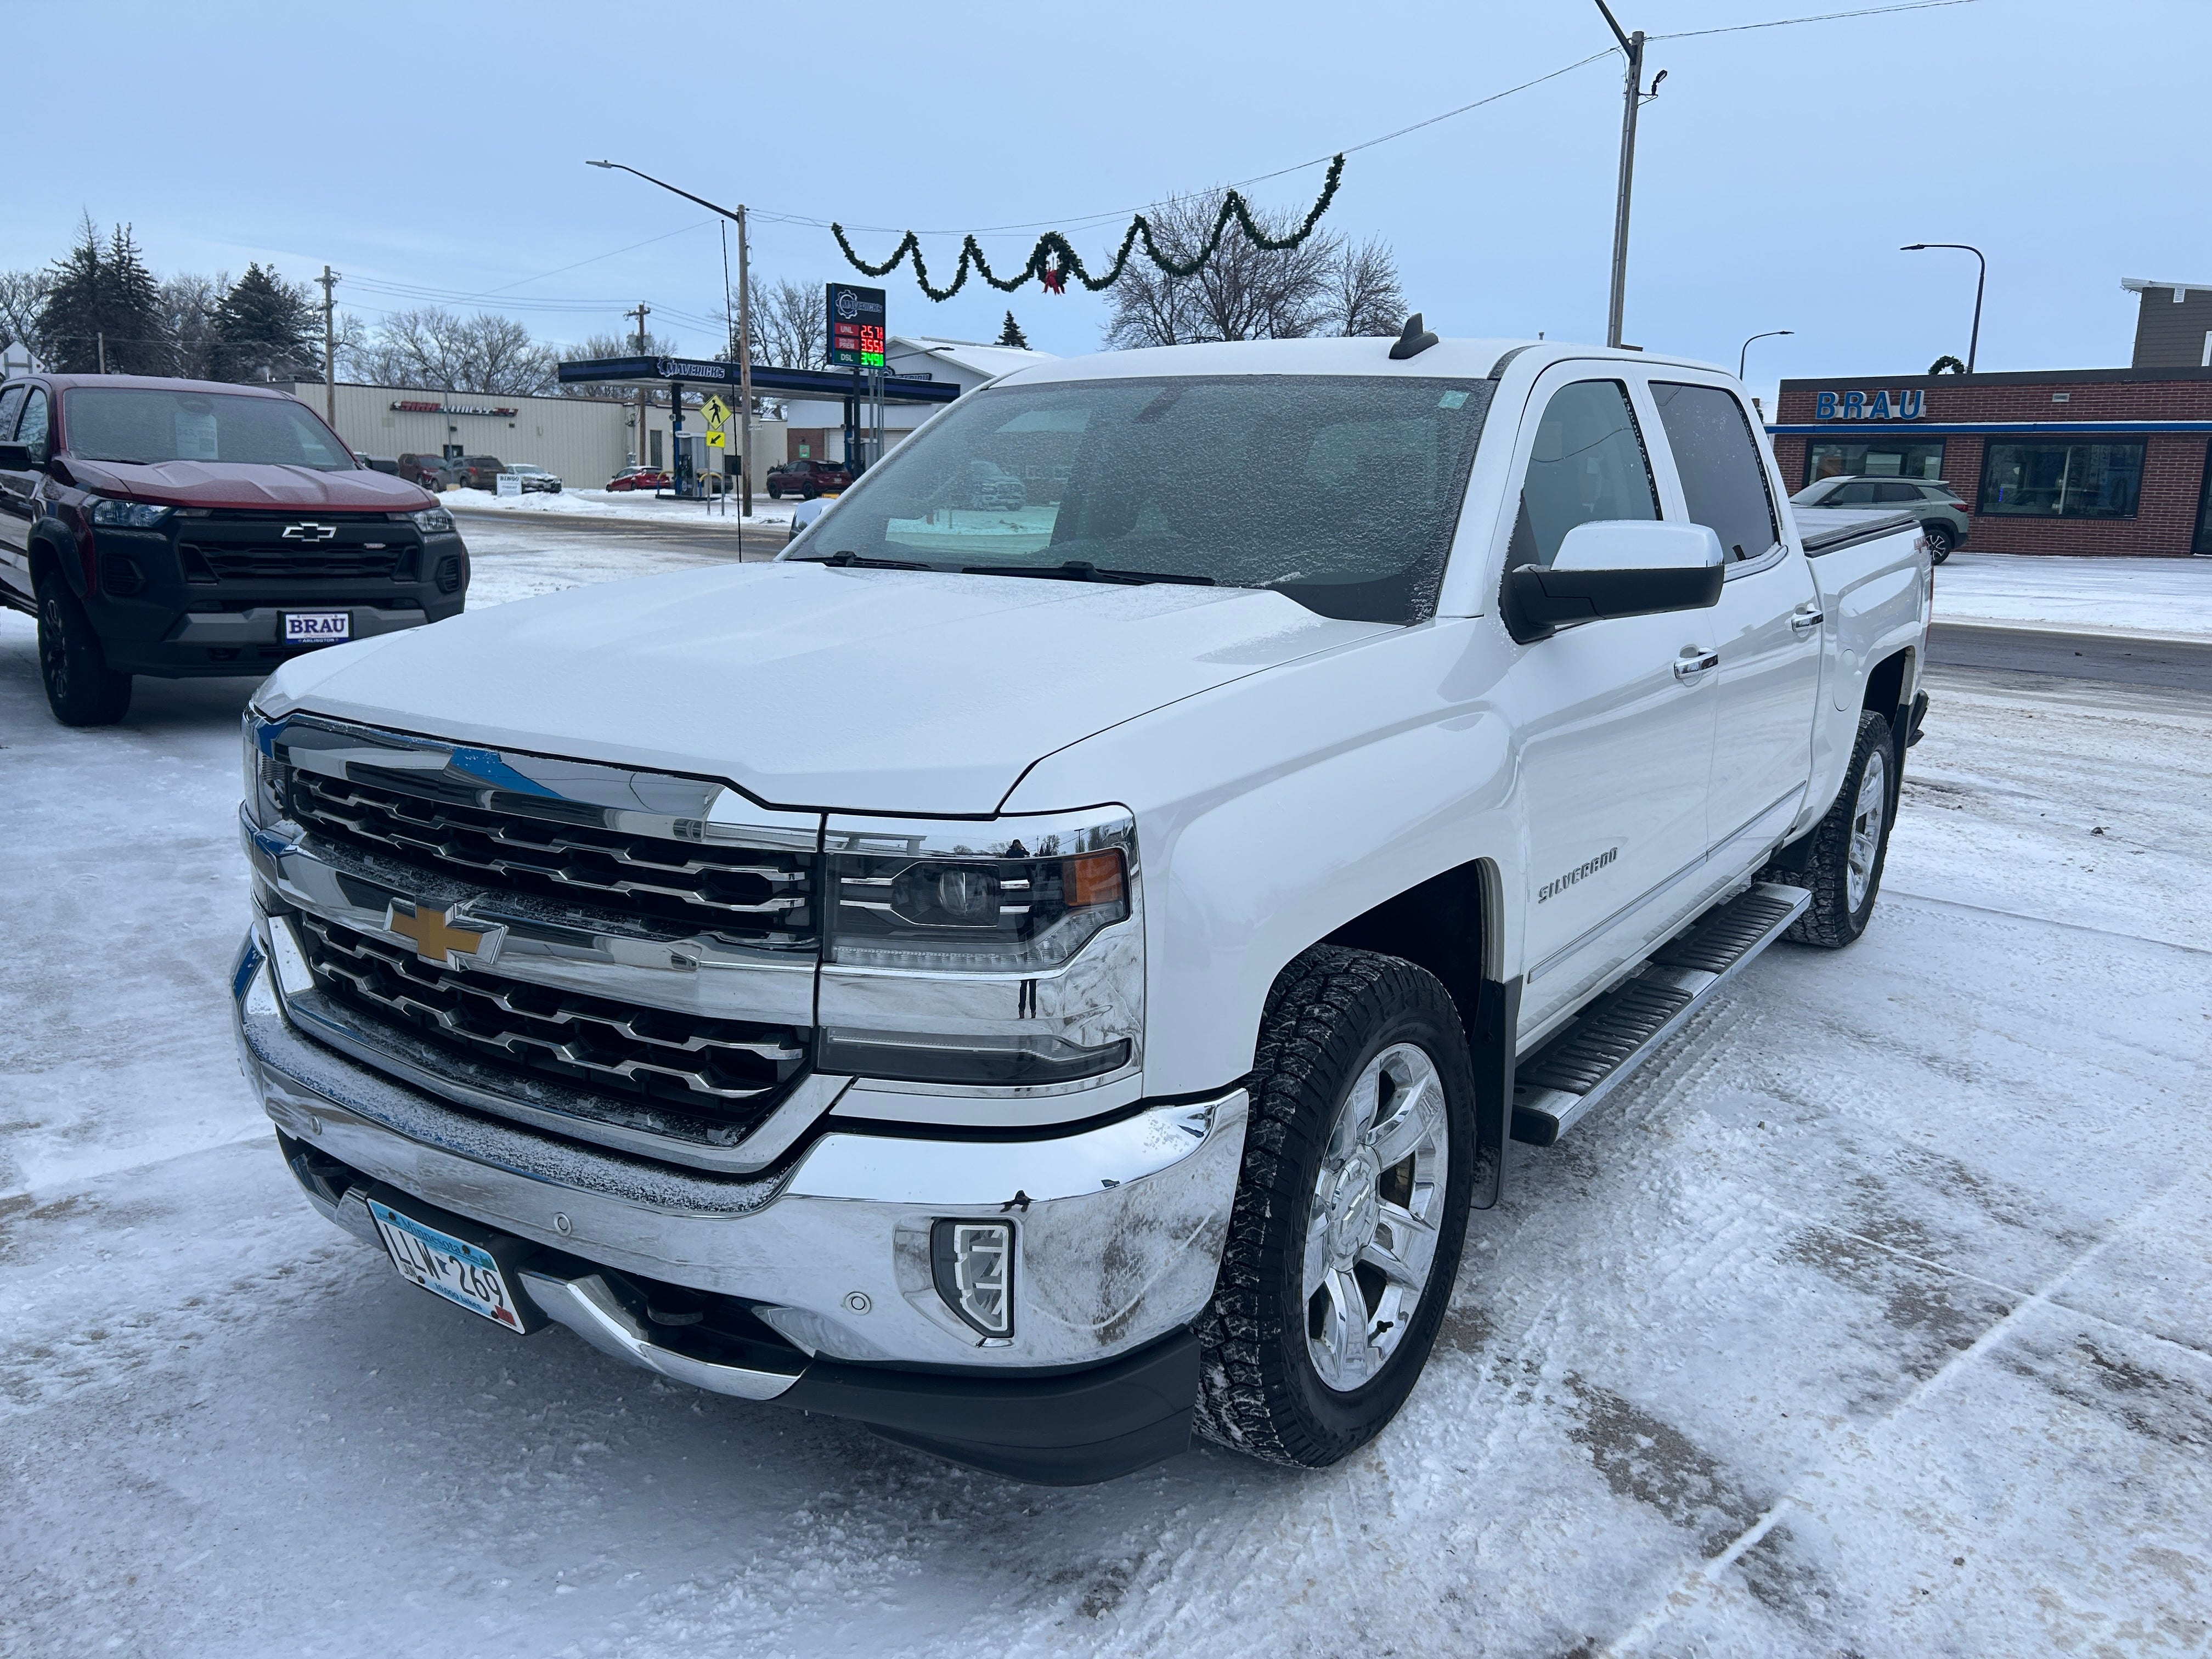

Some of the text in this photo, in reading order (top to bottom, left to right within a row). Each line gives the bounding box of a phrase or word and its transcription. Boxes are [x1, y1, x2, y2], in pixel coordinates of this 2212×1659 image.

[840, 325, 854, 334] UNL
[840, 353, 854, 362] DSL
[667, 362, 725, 379] MAVERICKS
[1815, 390, 1925, 420] BRAU
[289, 618, 345, 634] BRAU
[1538, 847, 1618, 904] SILVERADO
[400, 1217, 462, 1255] Minnesota
[383, 1223, 504, 1308] LLW 269
[434, 1283, 459, 1299] 10,000
